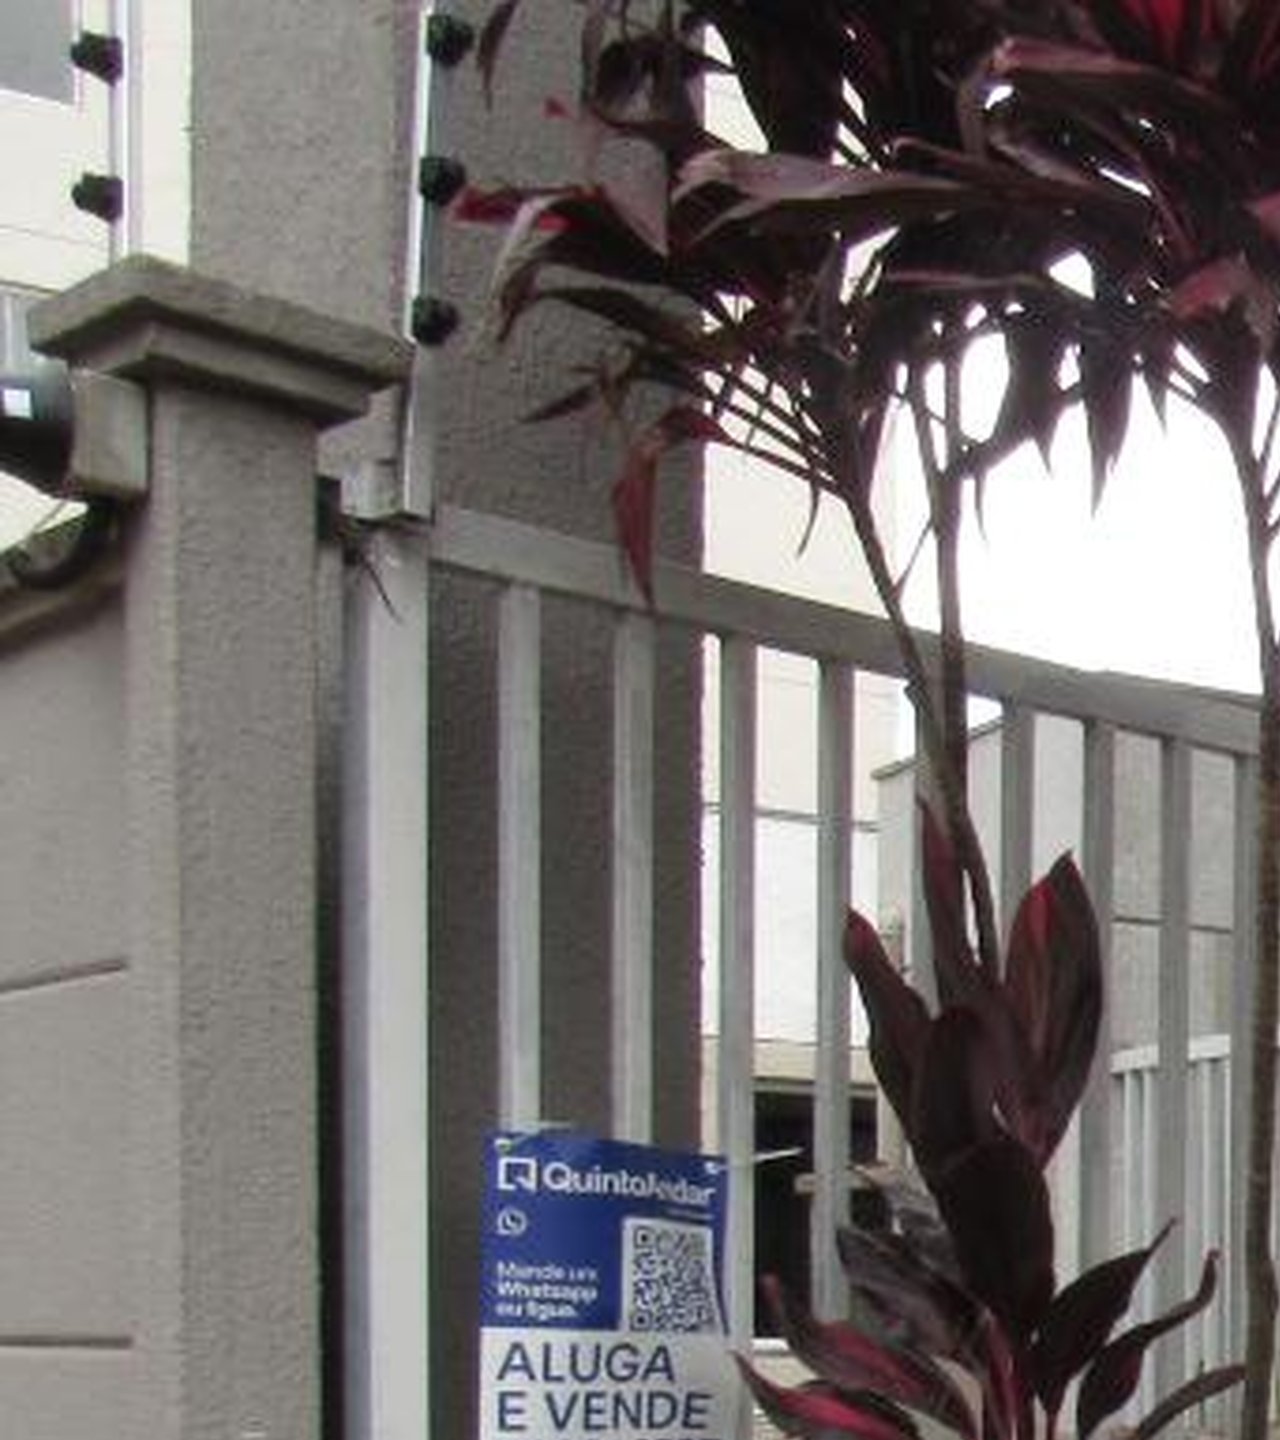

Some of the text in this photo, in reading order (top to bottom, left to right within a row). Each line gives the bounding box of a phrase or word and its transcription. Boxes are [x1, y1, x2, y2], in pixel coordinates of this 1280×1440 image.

[497, 1342, 675, 1383] ALUGA
[498, 1390, 714, 1432] E VENDE
